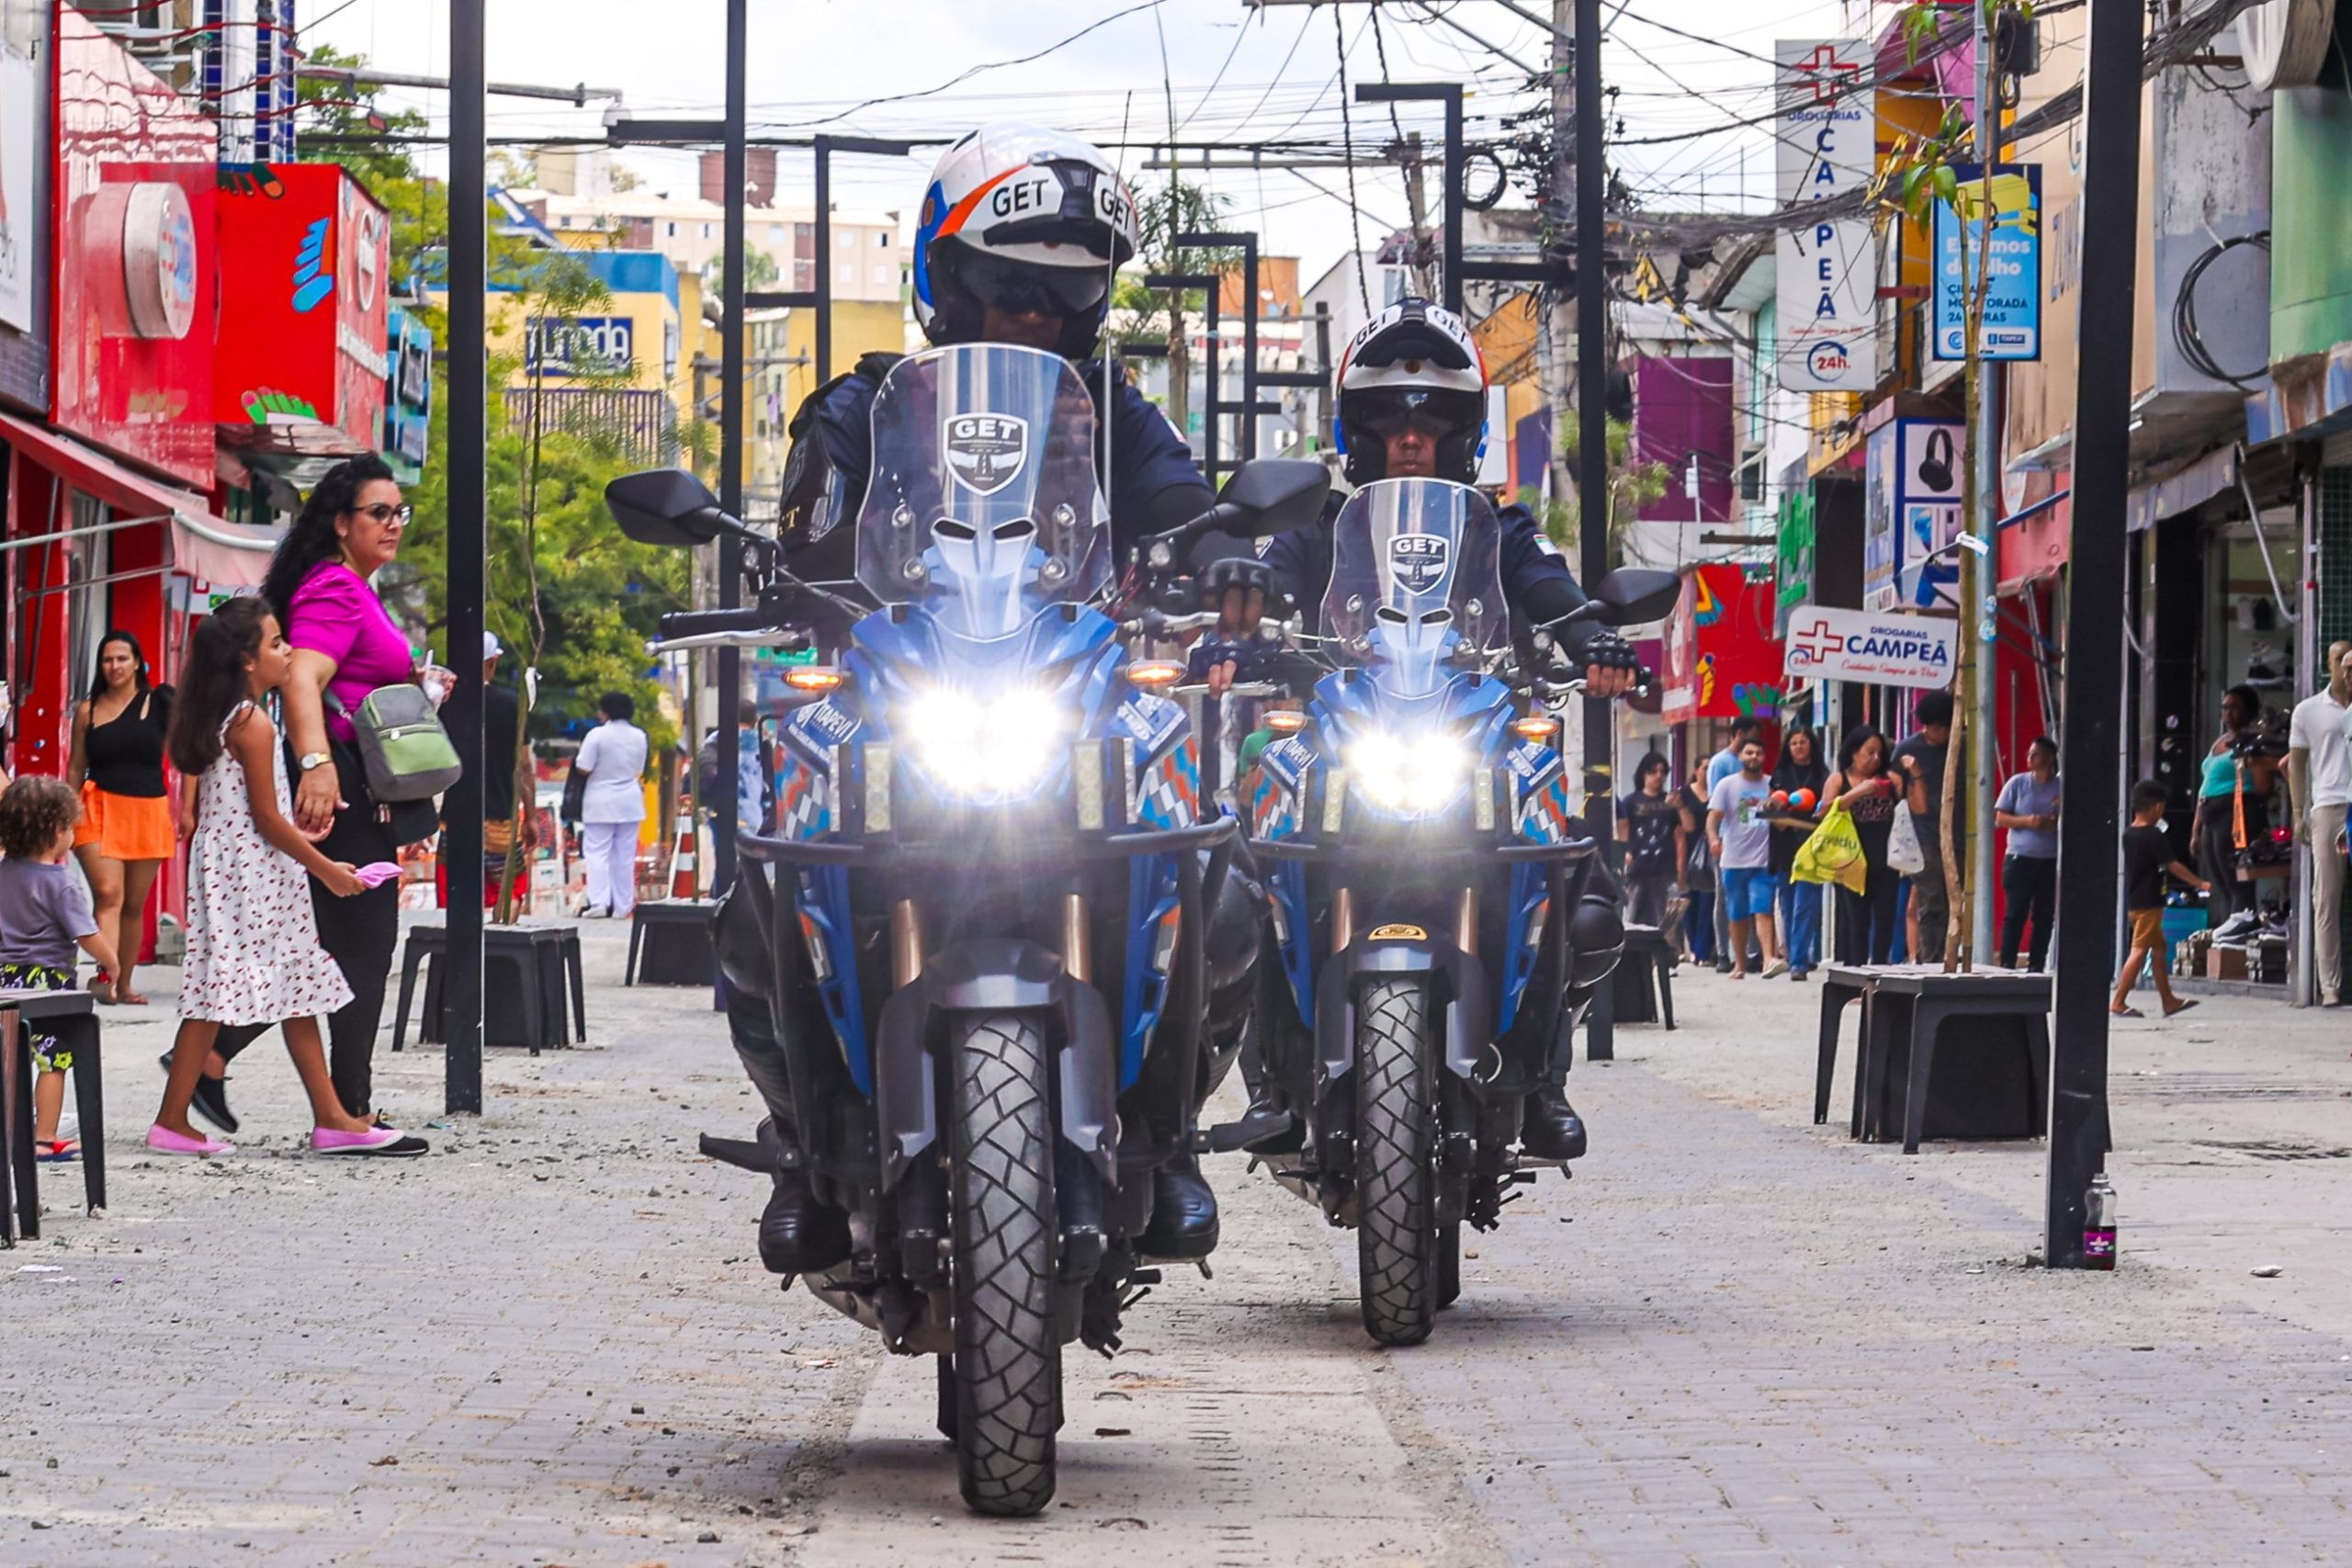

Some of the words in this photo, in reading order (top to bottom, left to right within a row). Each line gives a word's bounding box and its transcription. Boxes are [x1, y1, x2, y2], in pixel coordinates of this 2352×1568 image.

[992, 179, 1049, 217] GET
[1101, 188, 1131, 231] GET
[1815, 129, 1836, 316] CAPEÃ
[1356, 310, 1393, 345] GET
[955, 419, 1018, 439] GET
[1396, 538, 1442, 554] GET
[1847, 636, 1947, 662] CAMPEÃ
[1870, 626, 1928, 639] DROGARIAS
[815, 703, 853, 738] ITAPEVI
